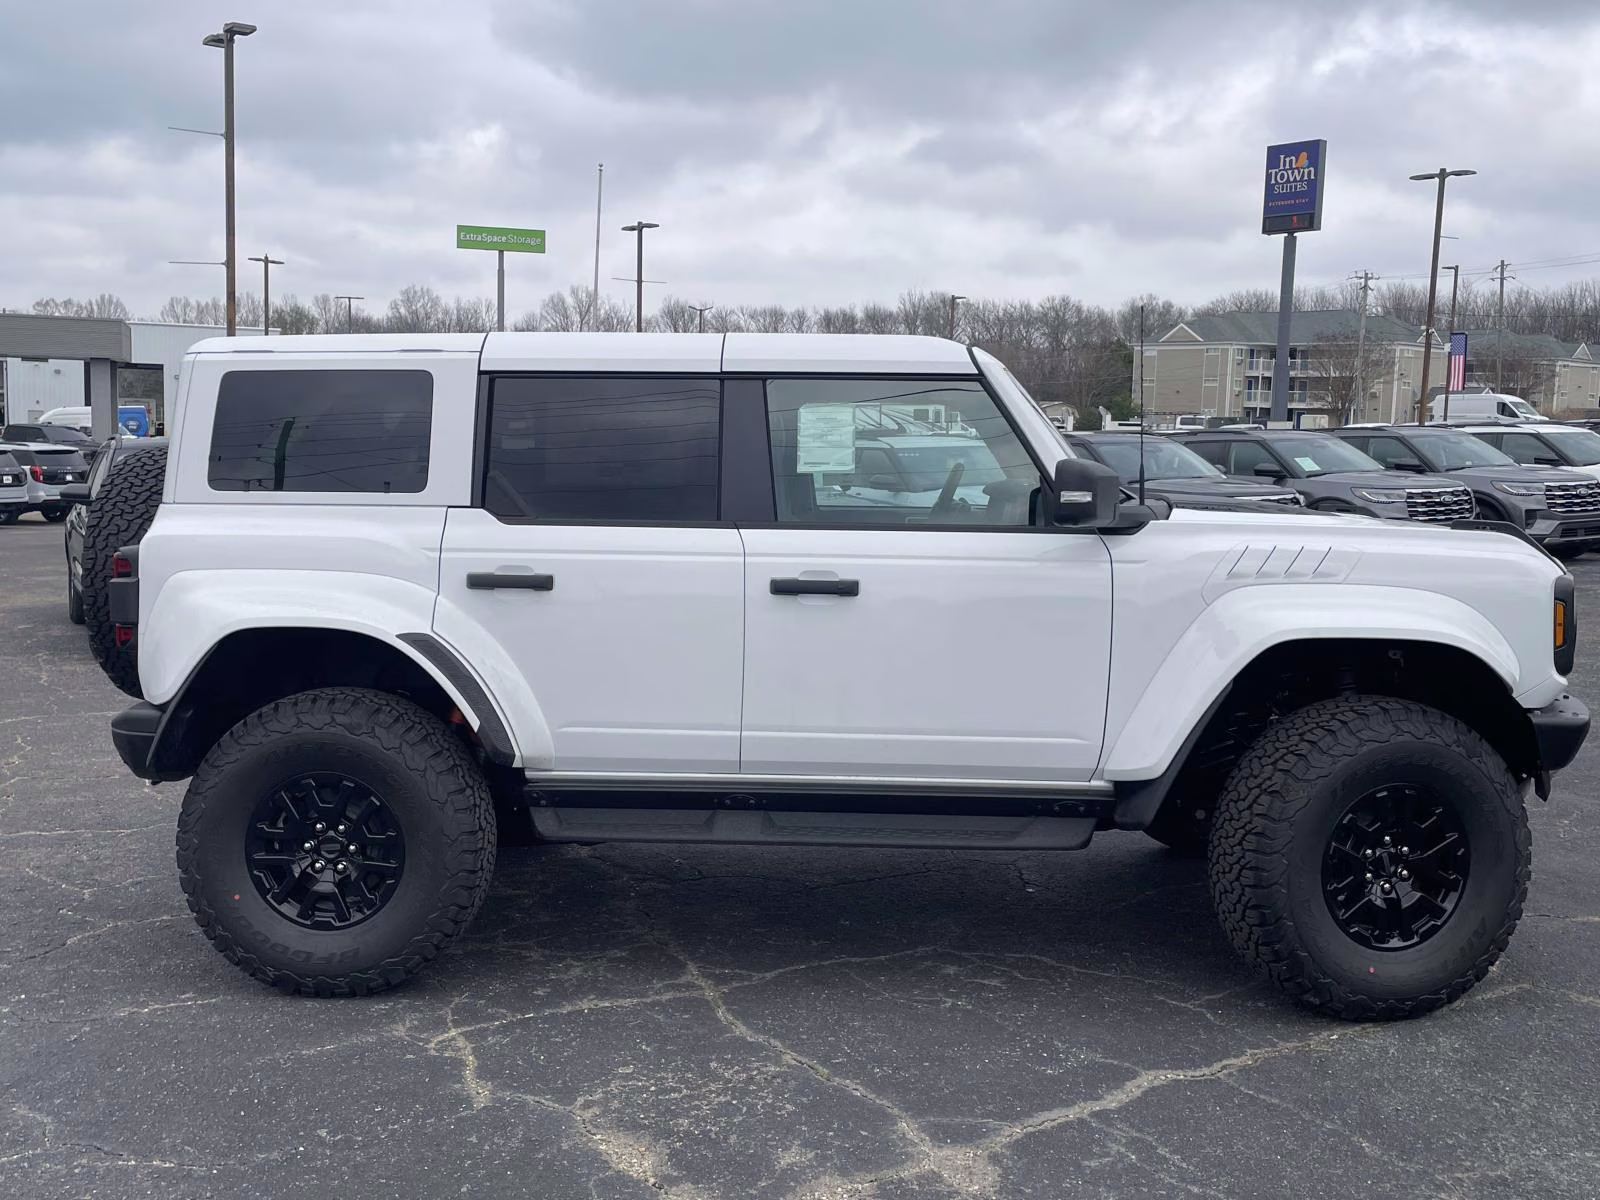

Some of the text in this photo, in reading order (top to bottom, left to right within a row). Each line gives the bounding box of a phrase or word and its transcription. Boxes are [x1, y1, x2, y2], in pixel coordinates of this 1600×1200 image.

[1279, 154, 1296, 169] In
[1268, 167, 1315, 184] Town
[1273, 182, 1308, 194] SUITES
[460, 233, 542, 246] ExtraSpace Storage
